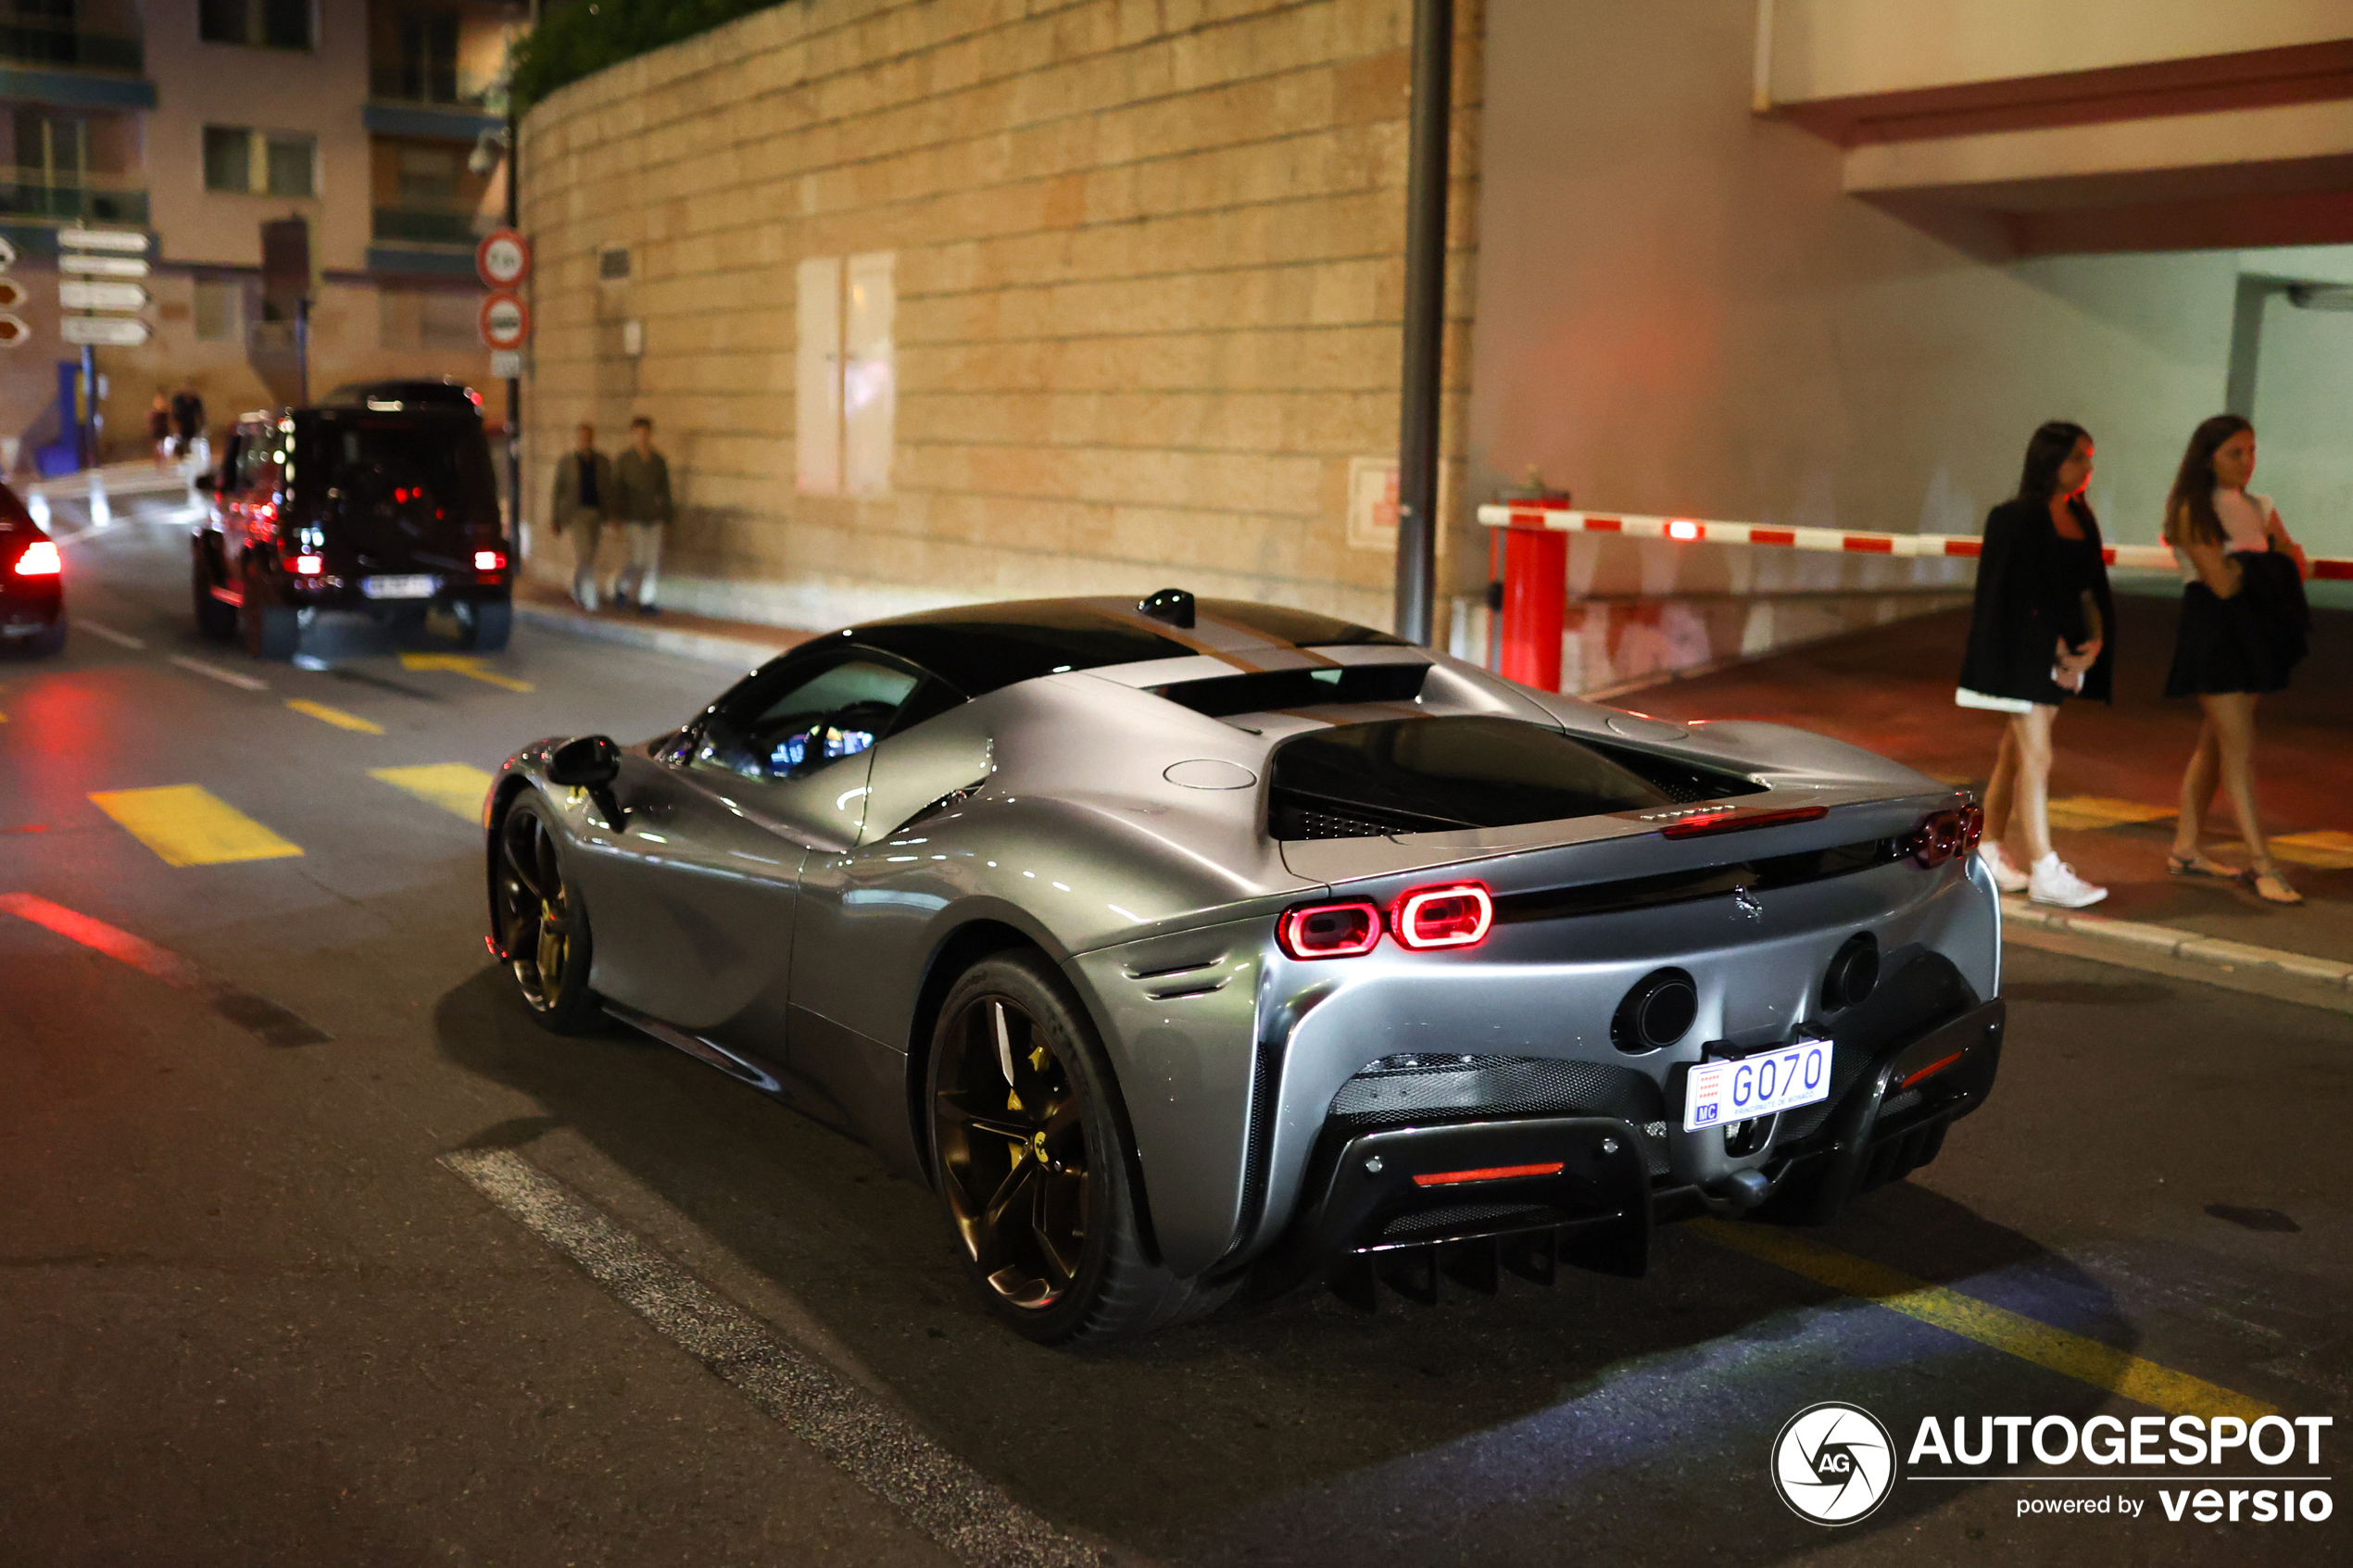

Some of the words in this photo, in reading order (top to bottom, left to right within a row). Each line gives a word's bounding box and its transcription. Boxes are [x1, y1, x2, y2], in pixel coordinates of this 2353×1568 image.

[1733, 1048, 1822, 1107] G070
[1788, 1091, 1814, 1103] MONACO
[1698, 1105, 1717, 1122] MC
